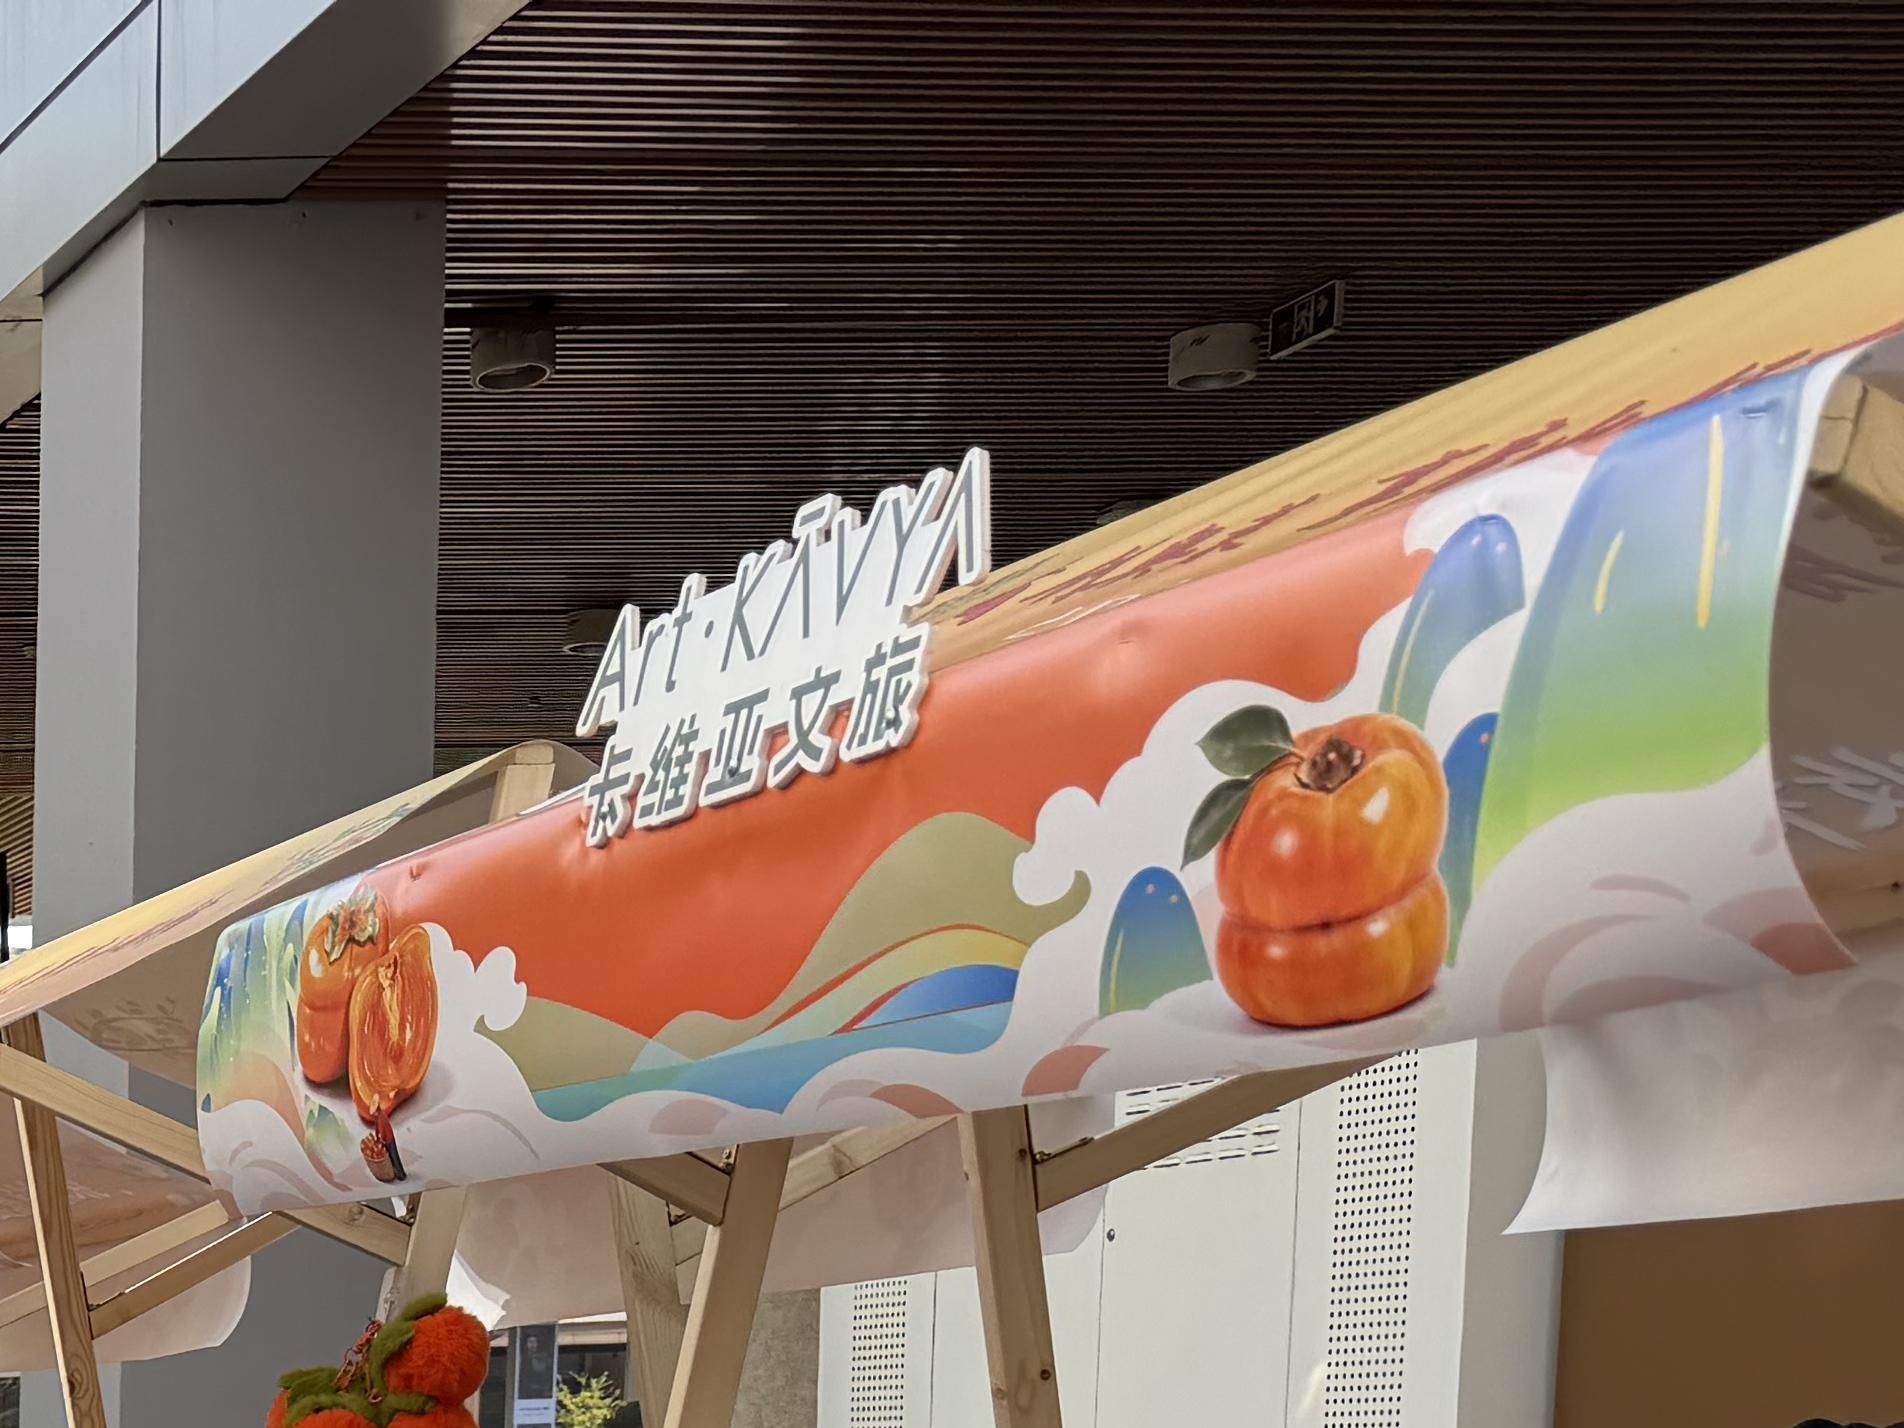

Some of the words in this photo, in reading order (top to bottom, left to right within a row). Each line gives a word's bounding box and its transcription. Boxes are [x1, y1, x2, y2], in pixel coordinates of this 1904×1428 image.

[589, 634, 922, 839] 卡维亚文旅
